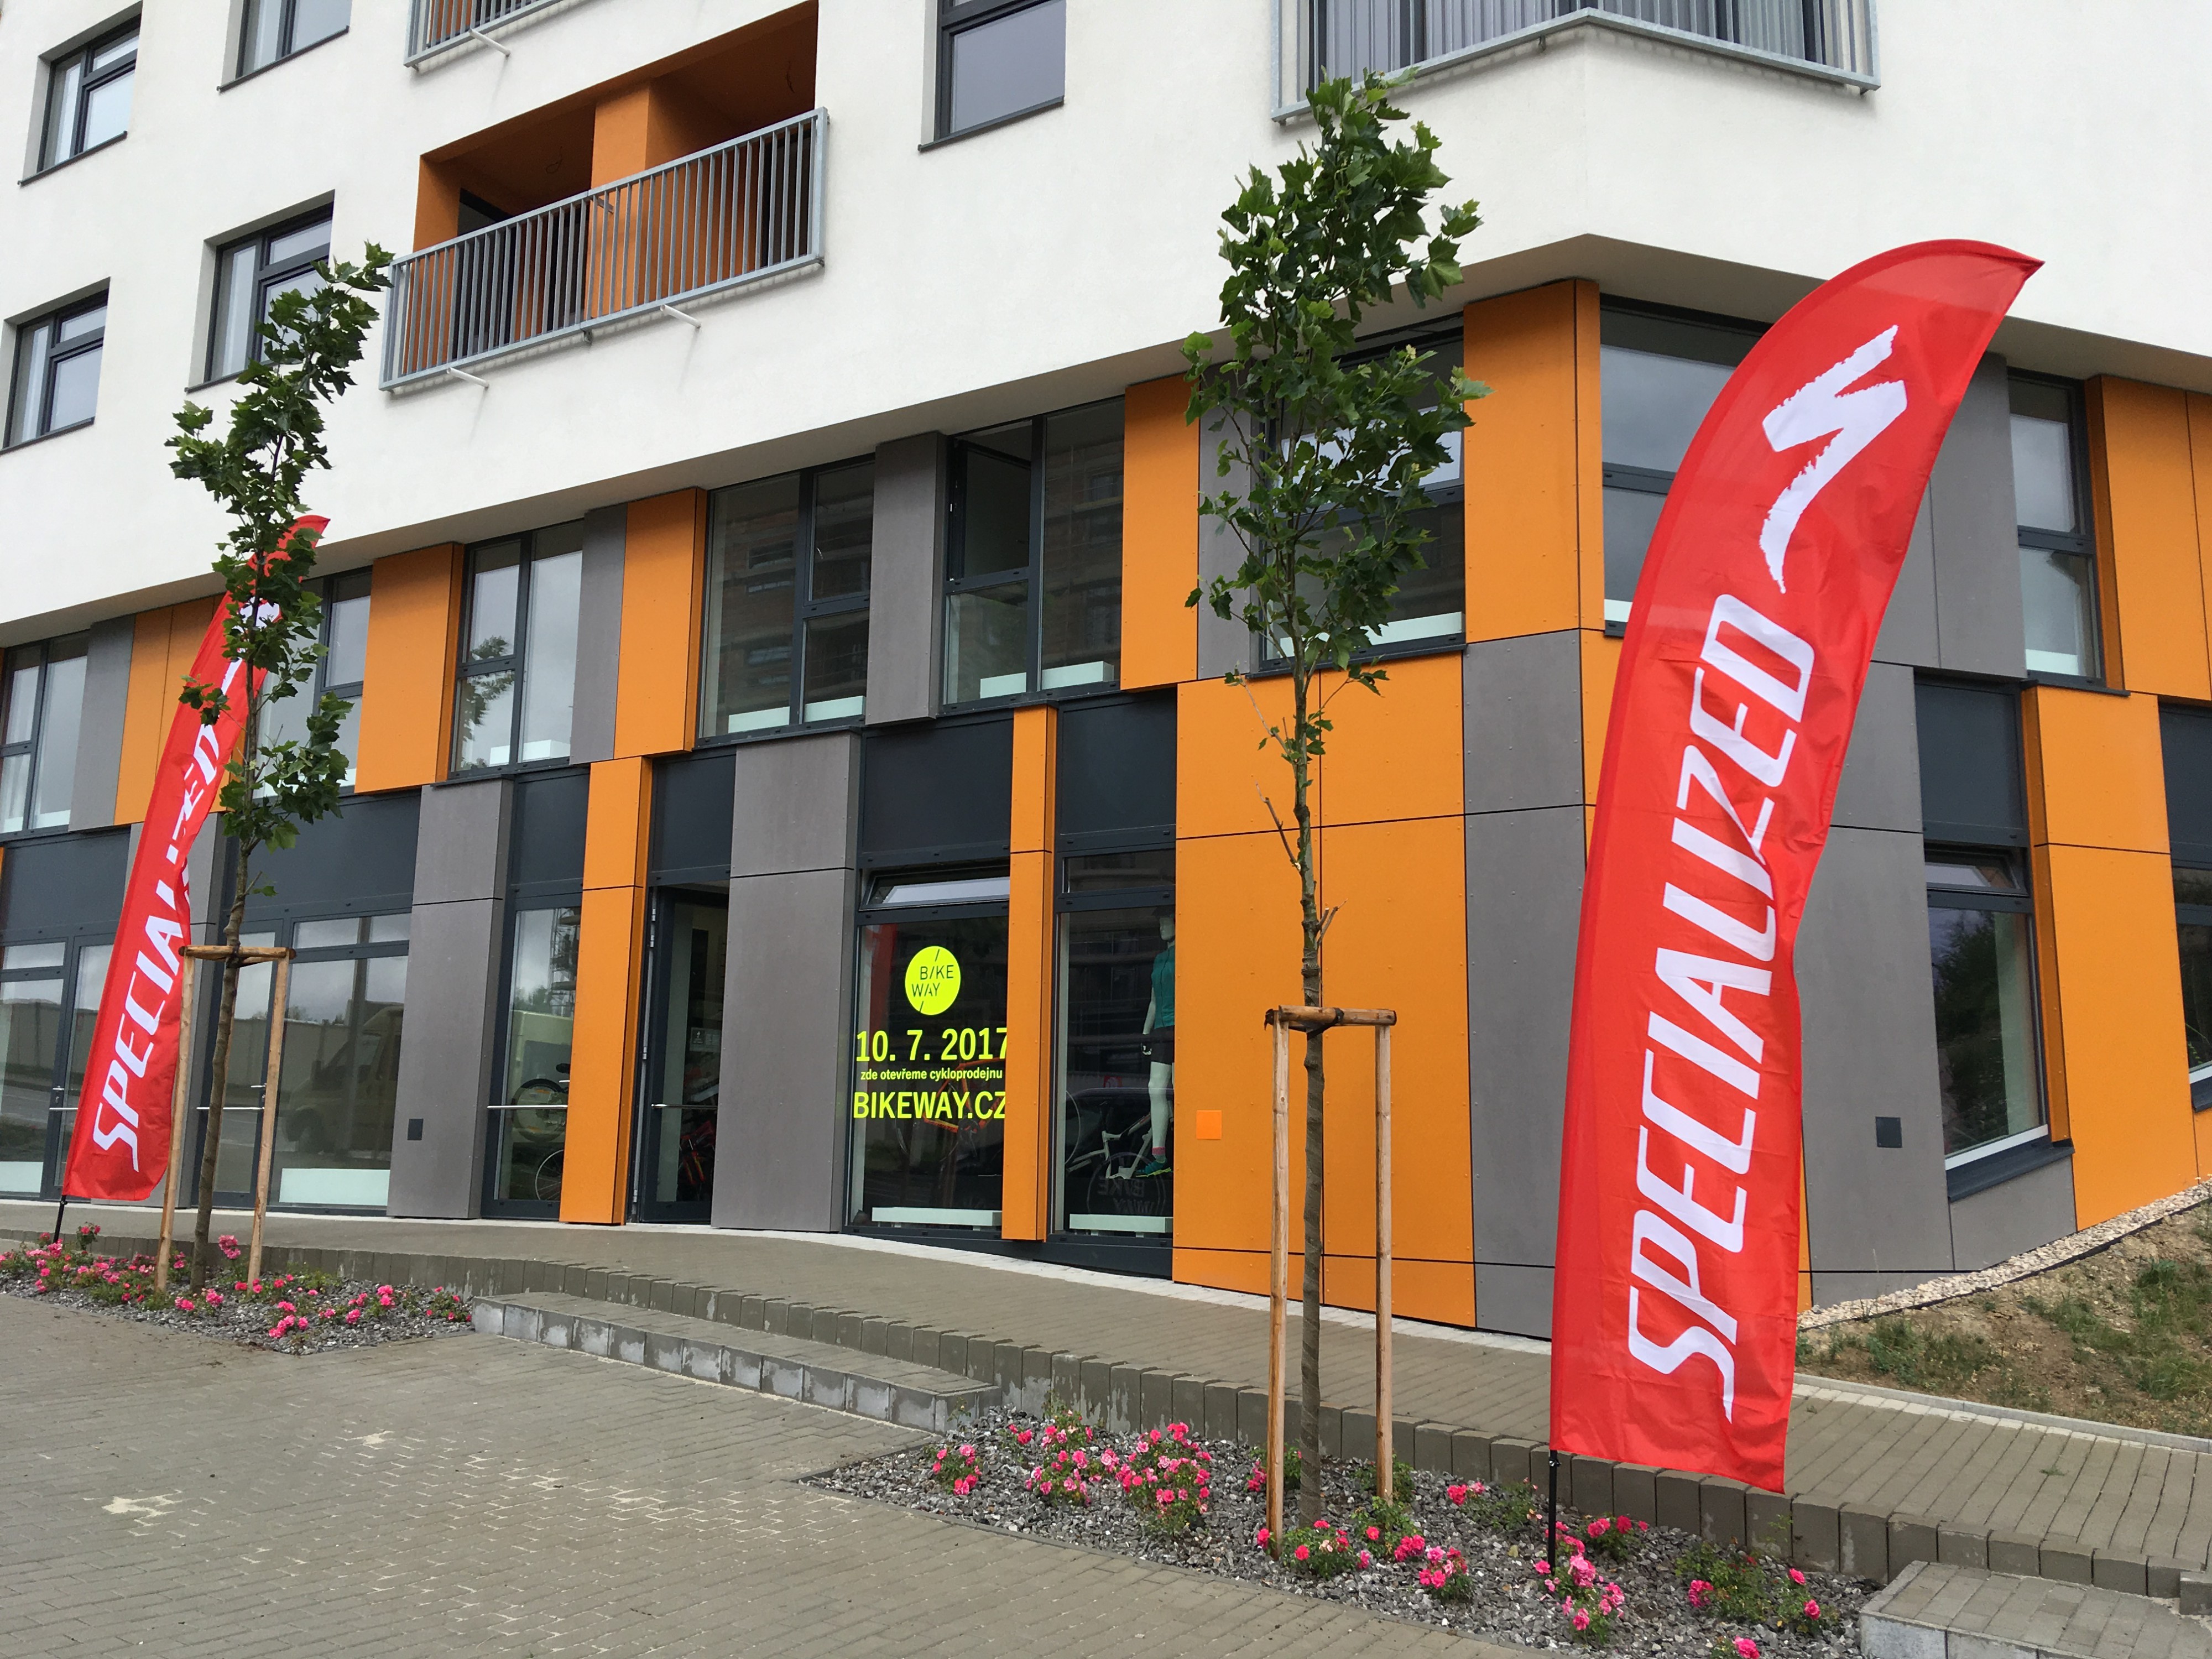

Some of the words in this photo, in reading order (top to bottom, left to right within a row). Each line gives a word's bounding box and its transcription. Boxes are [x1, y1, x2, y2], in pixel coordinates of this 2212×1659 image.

[920, 964, 954, 980] BIKE
[911, 982, 940, 997] WAY
[1628, 594, 1814, 1423] SPECIALIZED
[855, 1030, 895, 1062] 10.
[907, 1029, 930, 1061] 7.
[941, 1027, 1008, 1061] 2017
[861, 1068, 878, 1080] zde
[880, 1068, 927, 1080] otevřeme
[930, 1067, 1003, 1082] cykloprodejnu
[853, 1091, 1006, 1119] BIKEWAY.CZ
